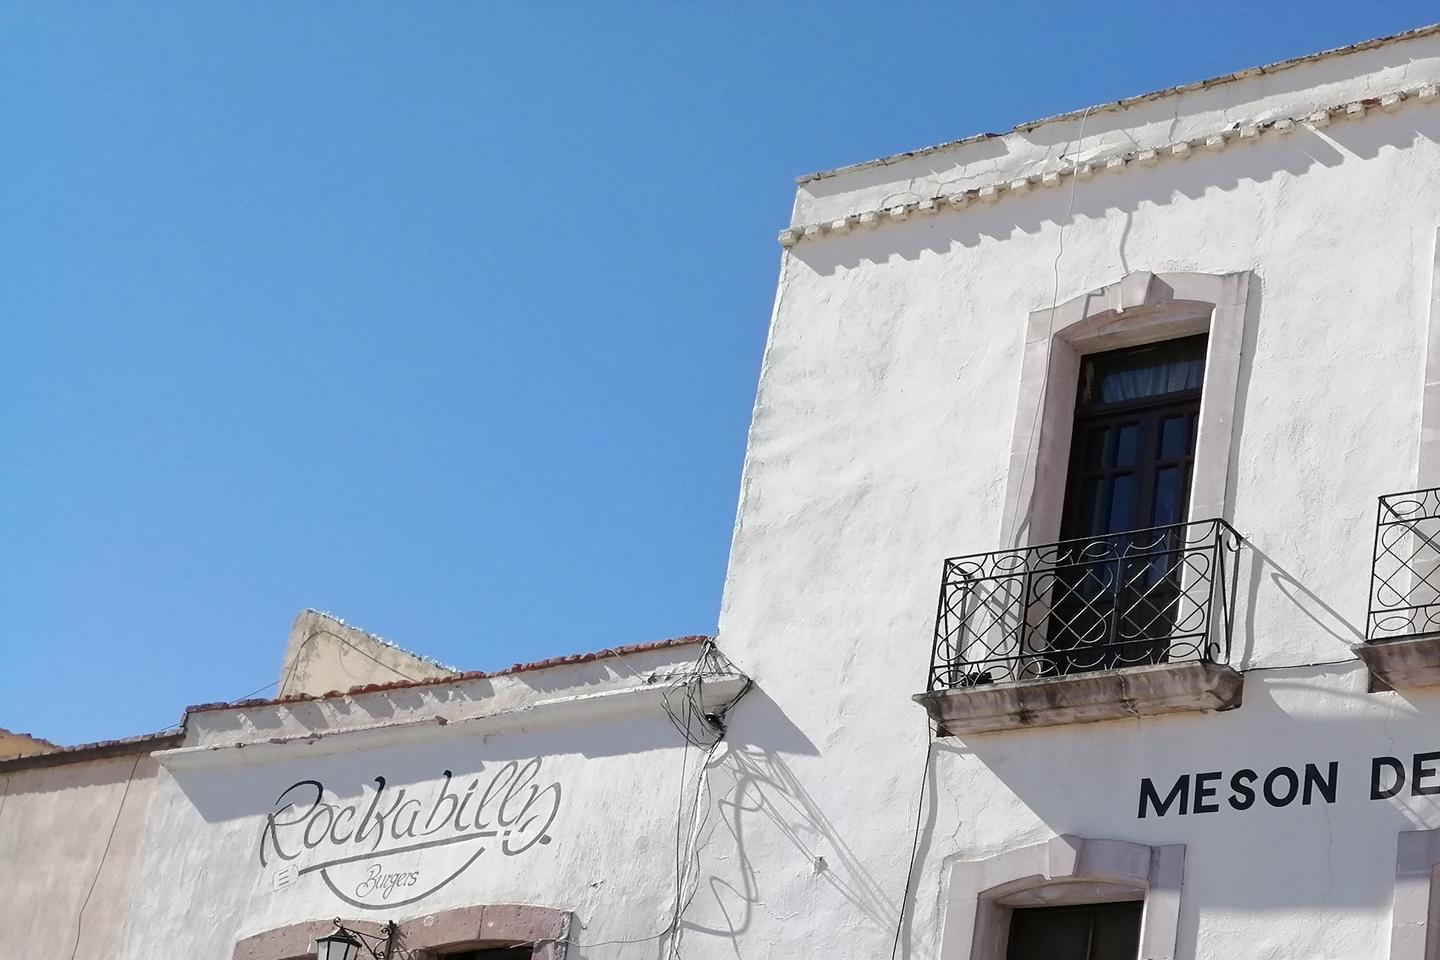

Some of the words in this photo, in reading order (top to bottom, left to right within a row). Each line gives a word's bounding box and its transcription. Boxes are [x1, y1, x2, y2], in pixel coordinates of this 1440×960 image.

[260, 756, 562, 868] Rockabilly
[1137, 761, 1339, 818] MESON
[355, 864, 419, 899] Burgers
